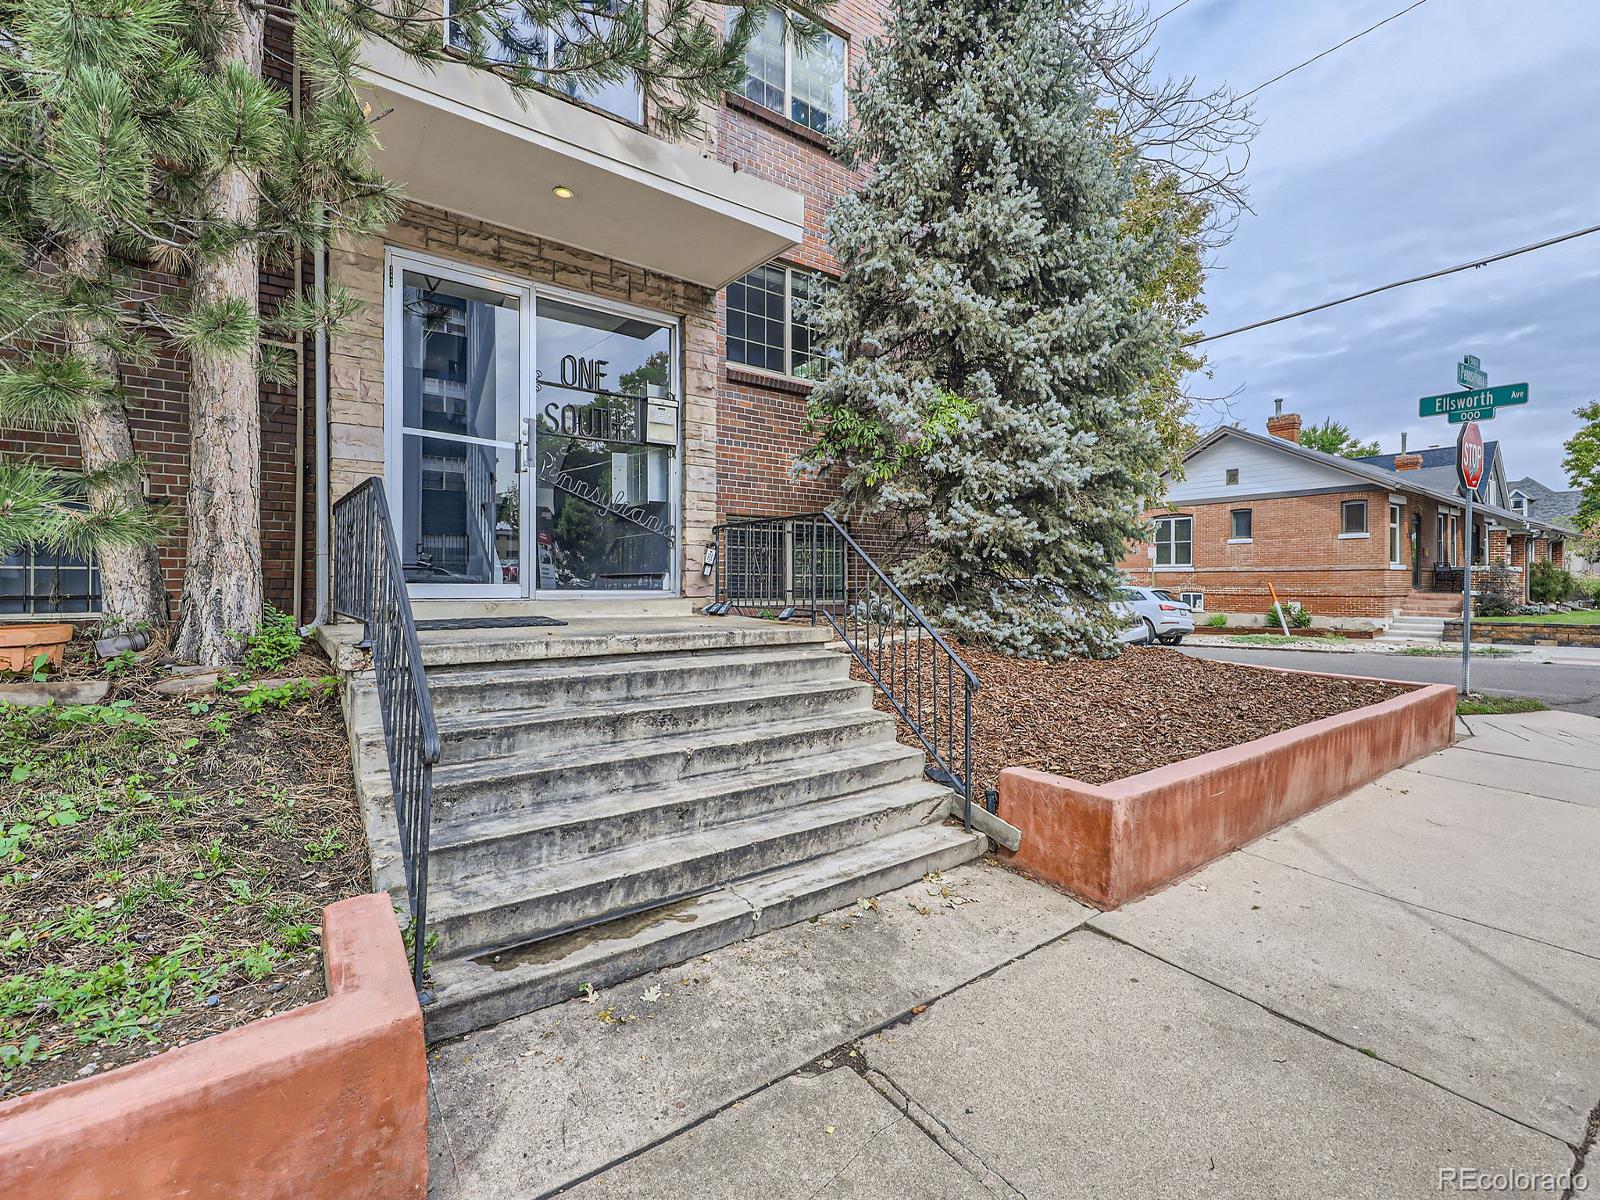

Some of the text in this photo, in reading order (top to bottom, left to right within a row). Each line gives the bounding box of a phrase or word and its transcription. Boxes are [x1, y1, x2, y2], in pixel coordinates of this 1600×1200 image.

[560, 355, 609, 391] ONE
[1435, 390, 1524, 412] Ellsworth Ave
[544, 402, 621, 441] SOUTH
[1460, 411, 1481, 421] 000
[1463, 443, 1482, 470] STOP
